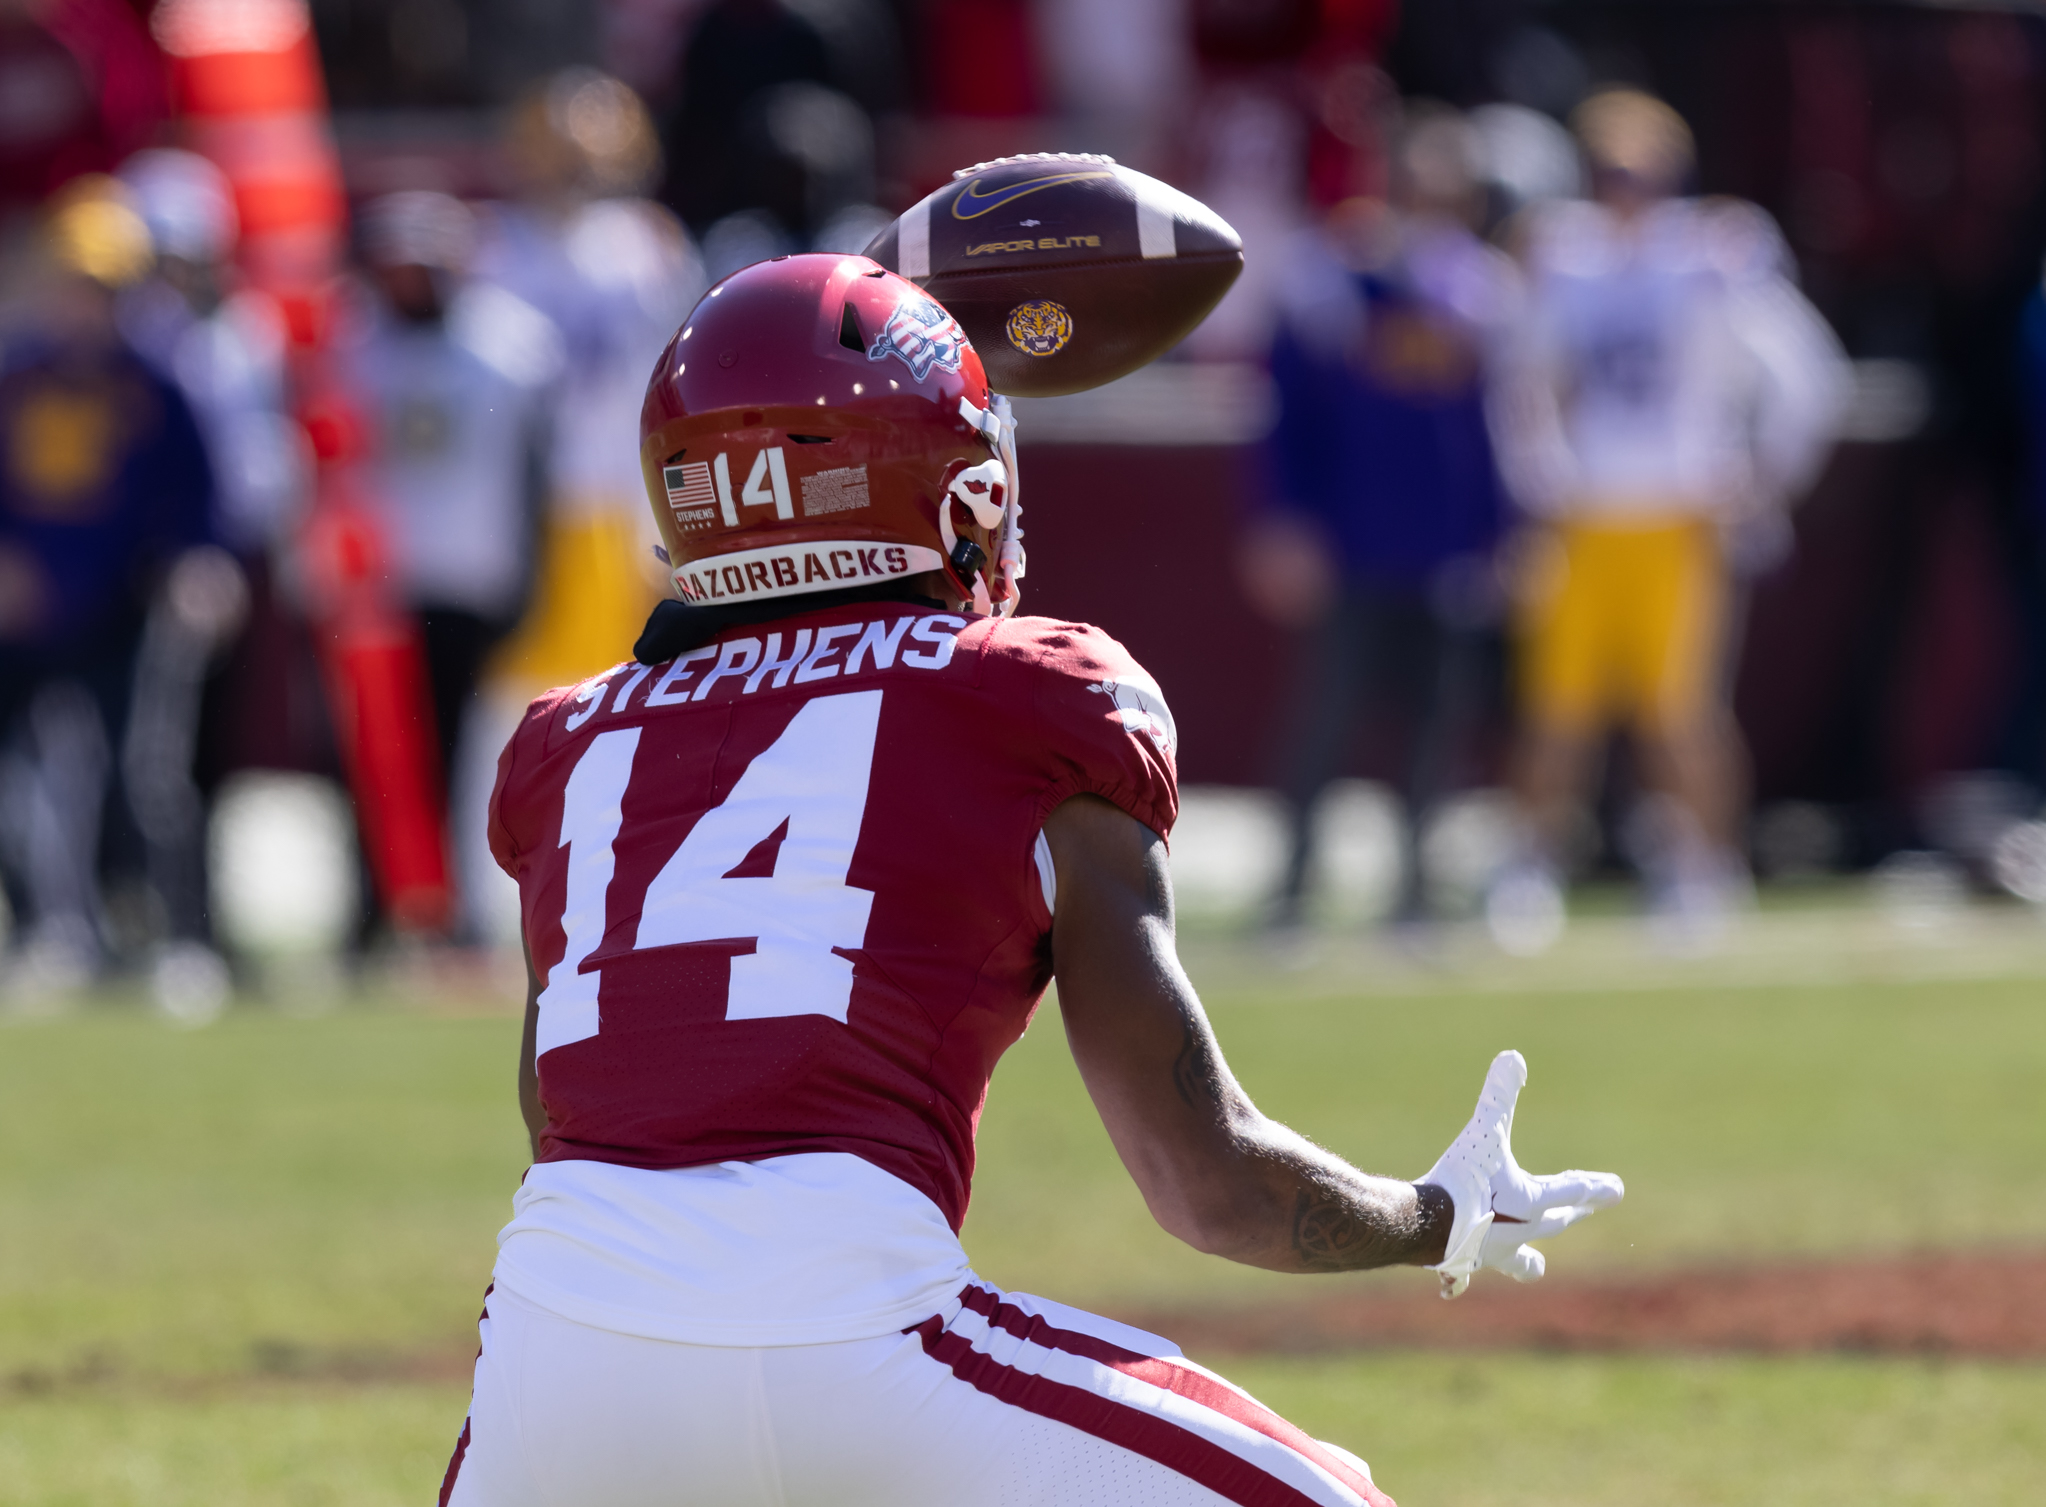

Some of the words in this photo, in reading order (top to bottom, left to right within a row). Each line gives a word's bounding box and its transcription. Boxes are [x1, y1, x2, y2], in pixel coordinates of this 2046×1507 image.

[967, 240, 1034, 256] VAPOR
[1038, 235, 1100, 248] ELITE
[676, 508, 714, 522] STEPHENS
[714, 447, 794, 526] 14
[676, 547, 908, 602] RAZORBACKS
[565, 614, 968, 732] STEPHENS
[535, 689, 884, 1077] 14
